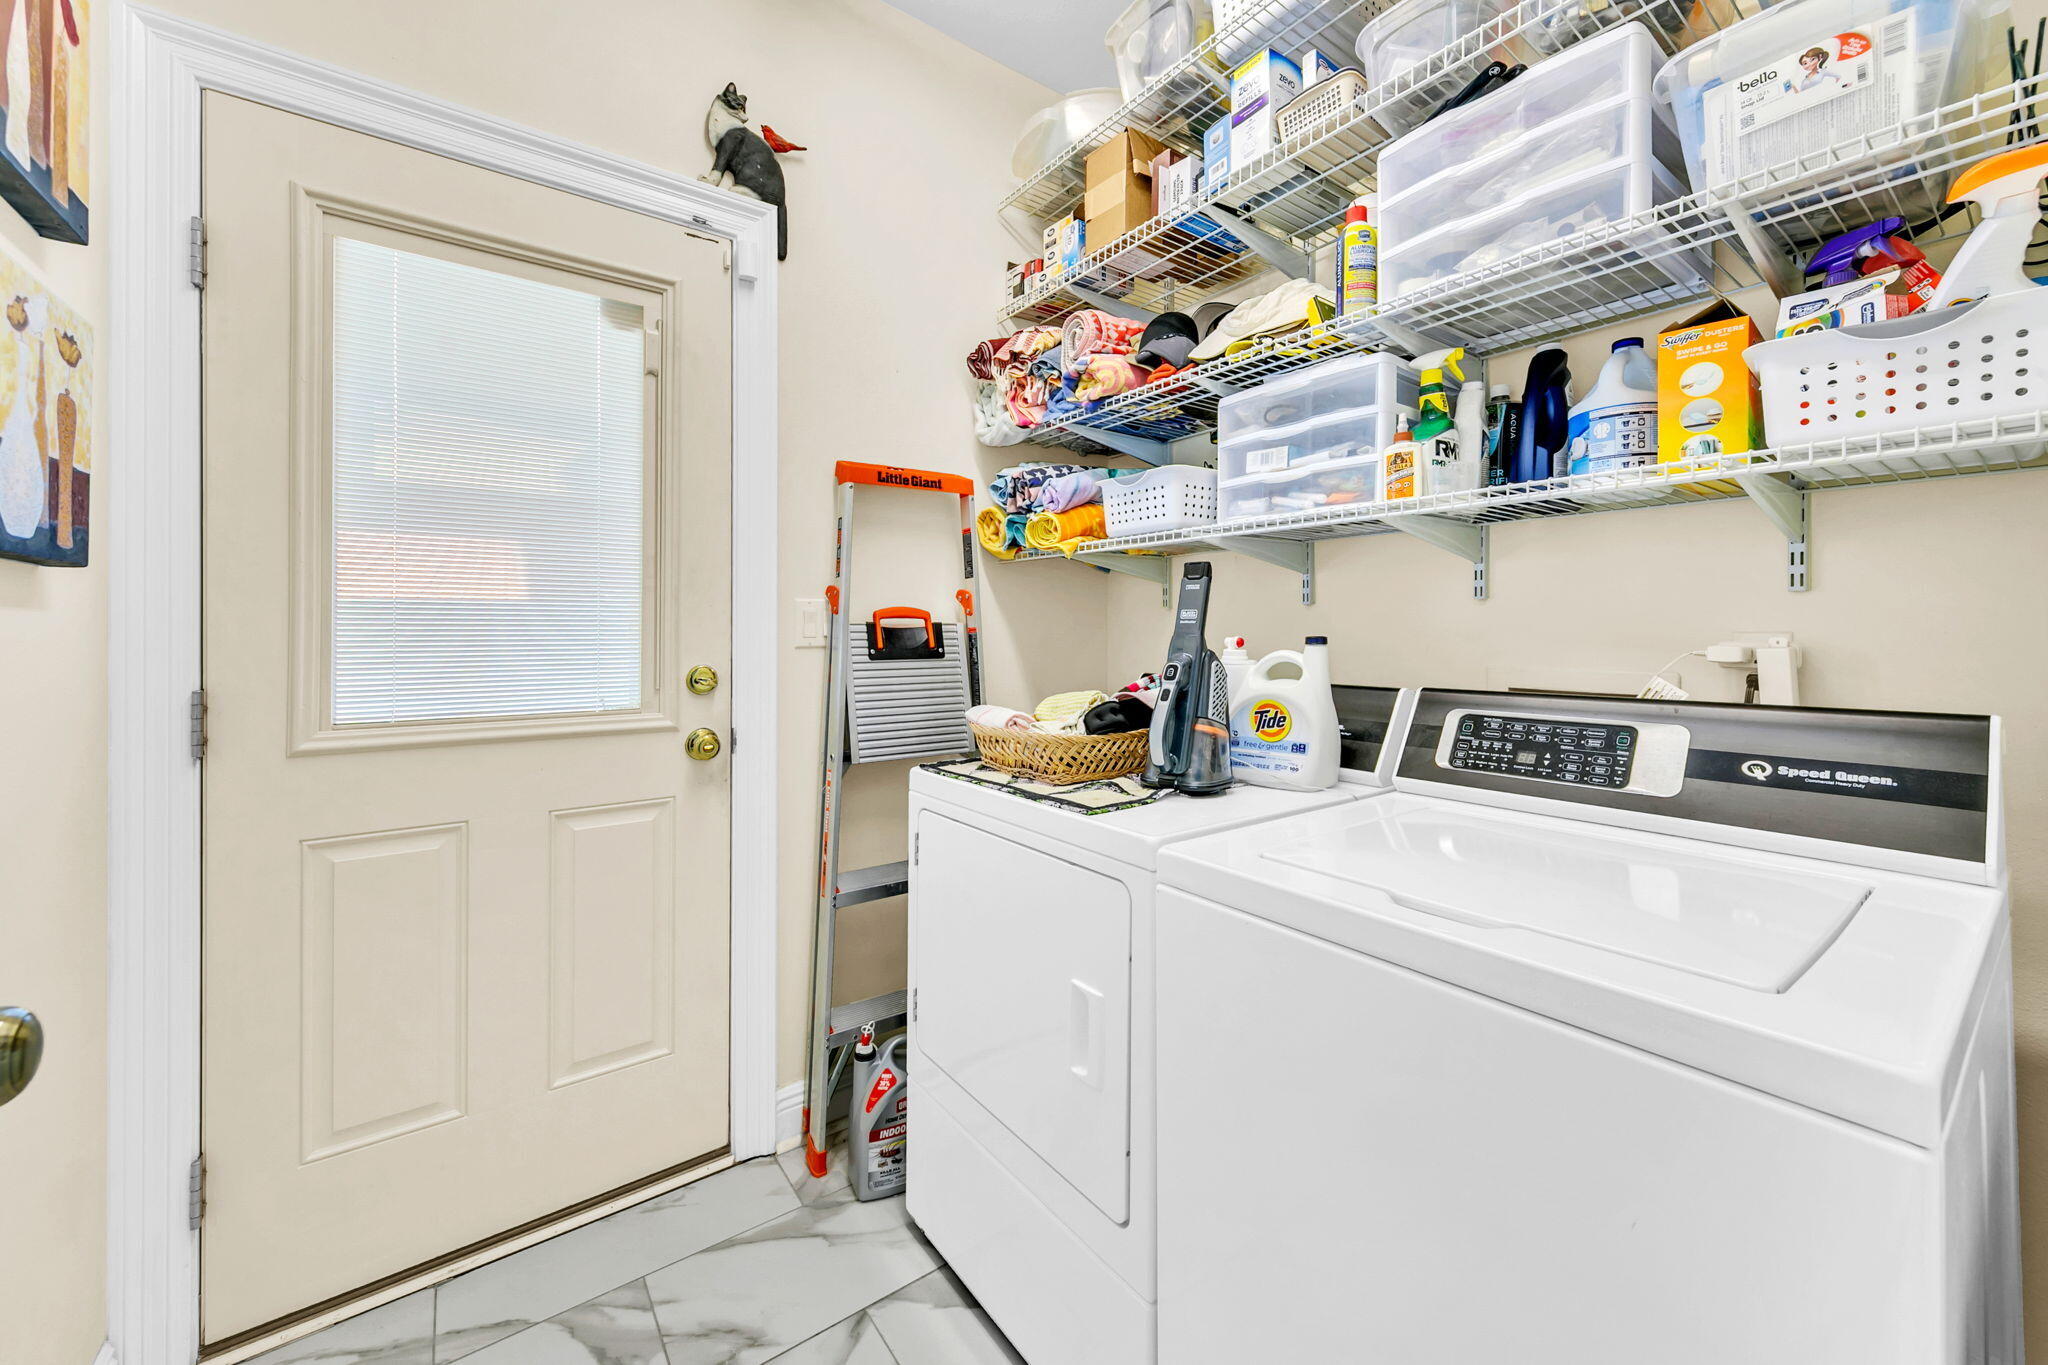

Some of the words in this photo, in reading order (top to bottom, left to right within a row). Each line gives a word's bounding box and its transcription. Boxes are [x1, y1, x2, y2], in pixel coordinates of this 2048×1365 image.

[1279, 73, 1296, 89] zevo
[1739, 70, 1778, 93] bella
[1661, 332, 1702, 346] Swiffer
[1705, 324, 1745, 336] DUSTERS
[1676, 345, 1704, 356] SWIPE
[1714, 341, 1728, 349] GO
[877, 471, 910, 485] Little
[911, 475, 942, 489] Giant
[1490, 469, 1504, 477] ER
[1254, 710, 1286, 732] Tide
[1267, 743, 1288, 752] gentle
[1777, 765, 1831, 778] Speed
[1834, 770, 1894, 786] Queen
[1804, 778, 1834, 786] Commercial
[880, 1125, 906, 1140] INDOO
